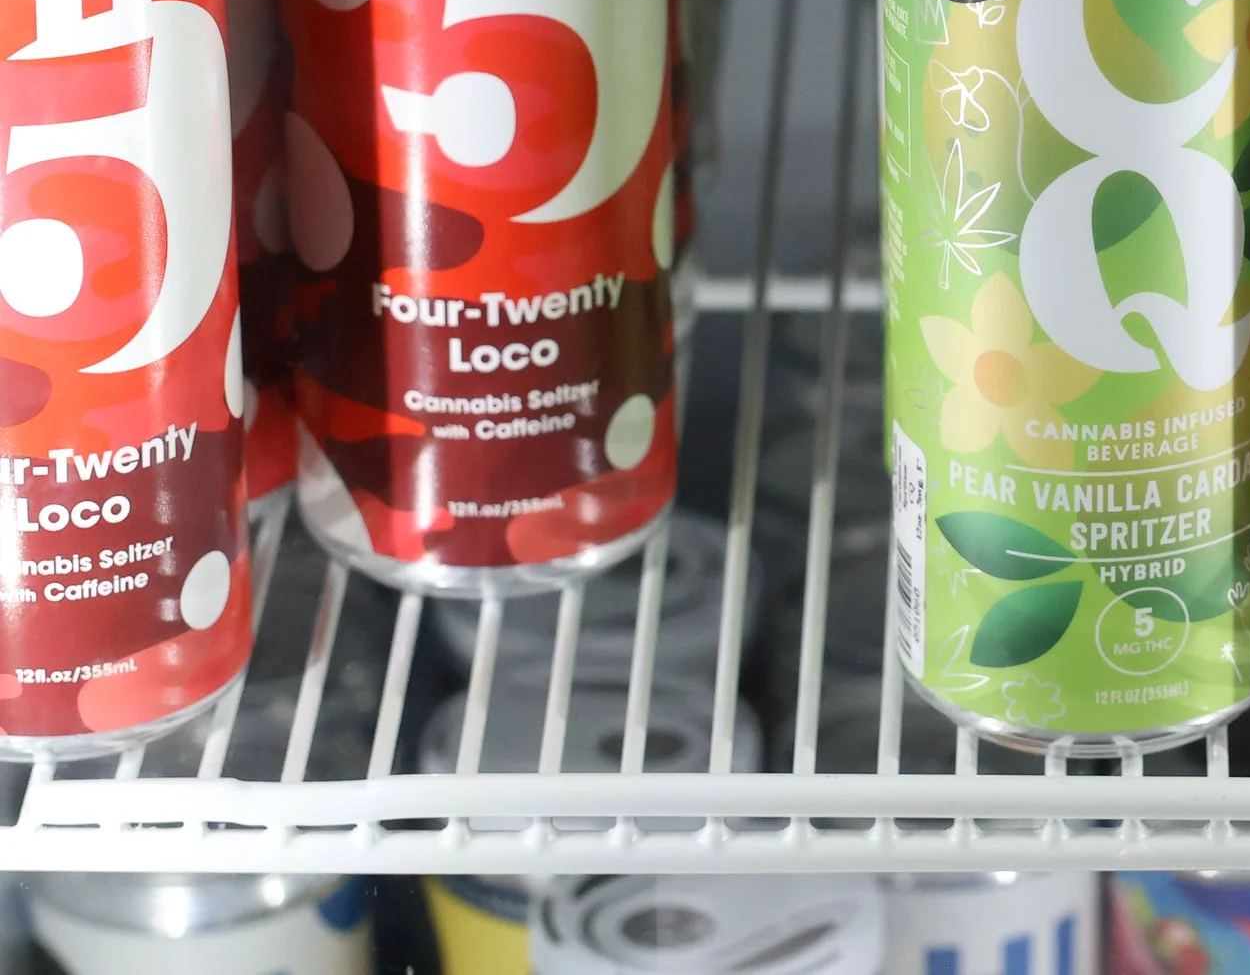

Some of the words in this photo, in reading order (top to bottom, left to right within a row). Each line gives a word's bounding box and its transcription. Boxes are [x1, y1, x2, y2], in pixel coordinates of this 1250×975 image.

[372, 271, 625, 327] Four-Twenty
[449, 337, 559, 373] Loco
[404, 389, 522, 415] Cannabis
[527, 379, 600, 410] Seltzer
[432, 425, 470, 440] with
[475, 413, 576, 440] Caffeine
[1025, 418, 1156, 441] CANNABIS
[1163, 396, 1246, 436] INFUSED
[1087, 433, 1199, 463] BEVERAGE
[949, 458, 1016, 506] PEAR
[1033, 480, 1162, 514] VANILLA
[15, 495, 131, 532] Loco
[1070, 508, 1212, 552] SPRITZER
[99, 535, 174, 570] Seltzer
[1099, 557, 1187, 584] HYBRID
[44, 572, 150, 602] Caffeine
[1134, 607, 1154, 637] 5
[1113, 640, 1141, 656] MG
[1145, 637, 1173, 653] THC
[15, 657, 138, 684] 12fl.oz/355mL
[1094, 691, 1108, 705] 12
[1111, 690, 1123, 704] FL
[1125, 689, 1140, 703] OZ
